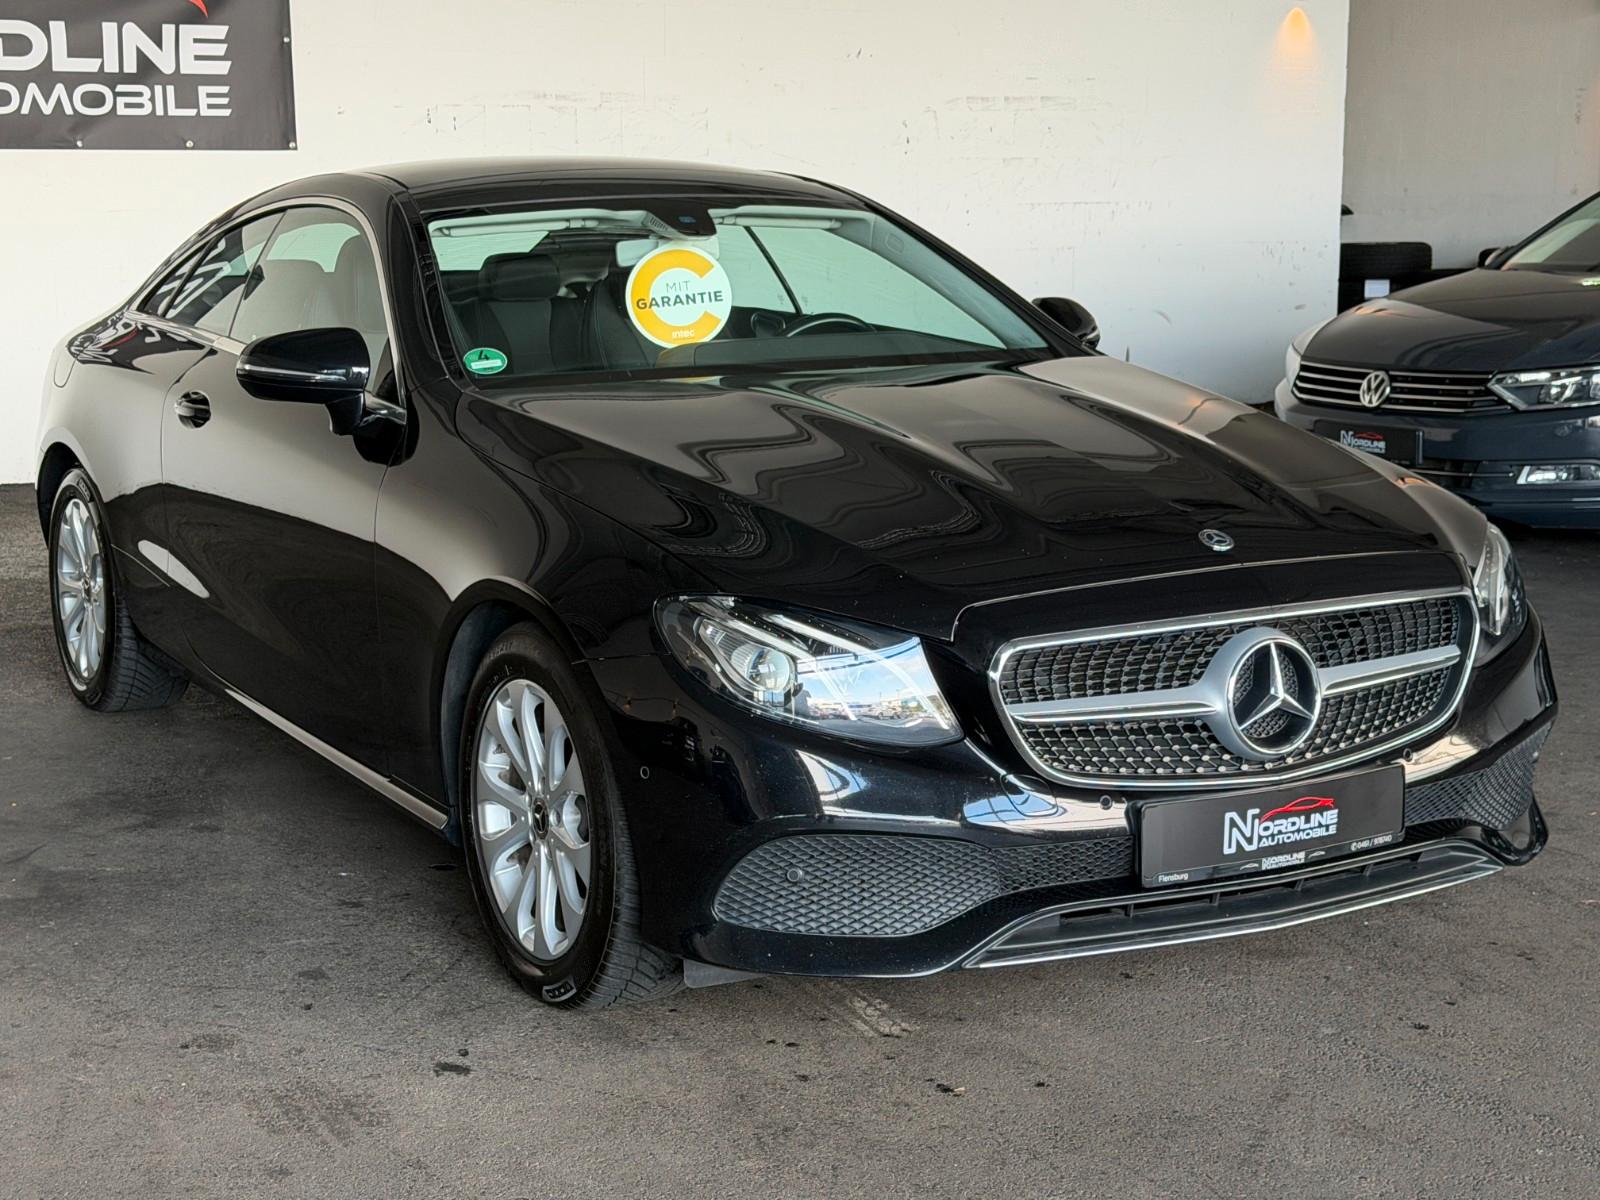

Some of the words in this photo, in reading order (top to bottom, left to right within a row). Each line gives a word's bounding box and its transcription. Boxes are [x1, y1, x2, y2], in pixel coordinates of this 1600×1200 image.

[665, 280, 691, 293] MIT
[636, 290, 724, 310] GARANTIE
[1258, 825, 1337, 848] AUTOMOBILE
[1158, 872, 1189, 883] Flensburg
